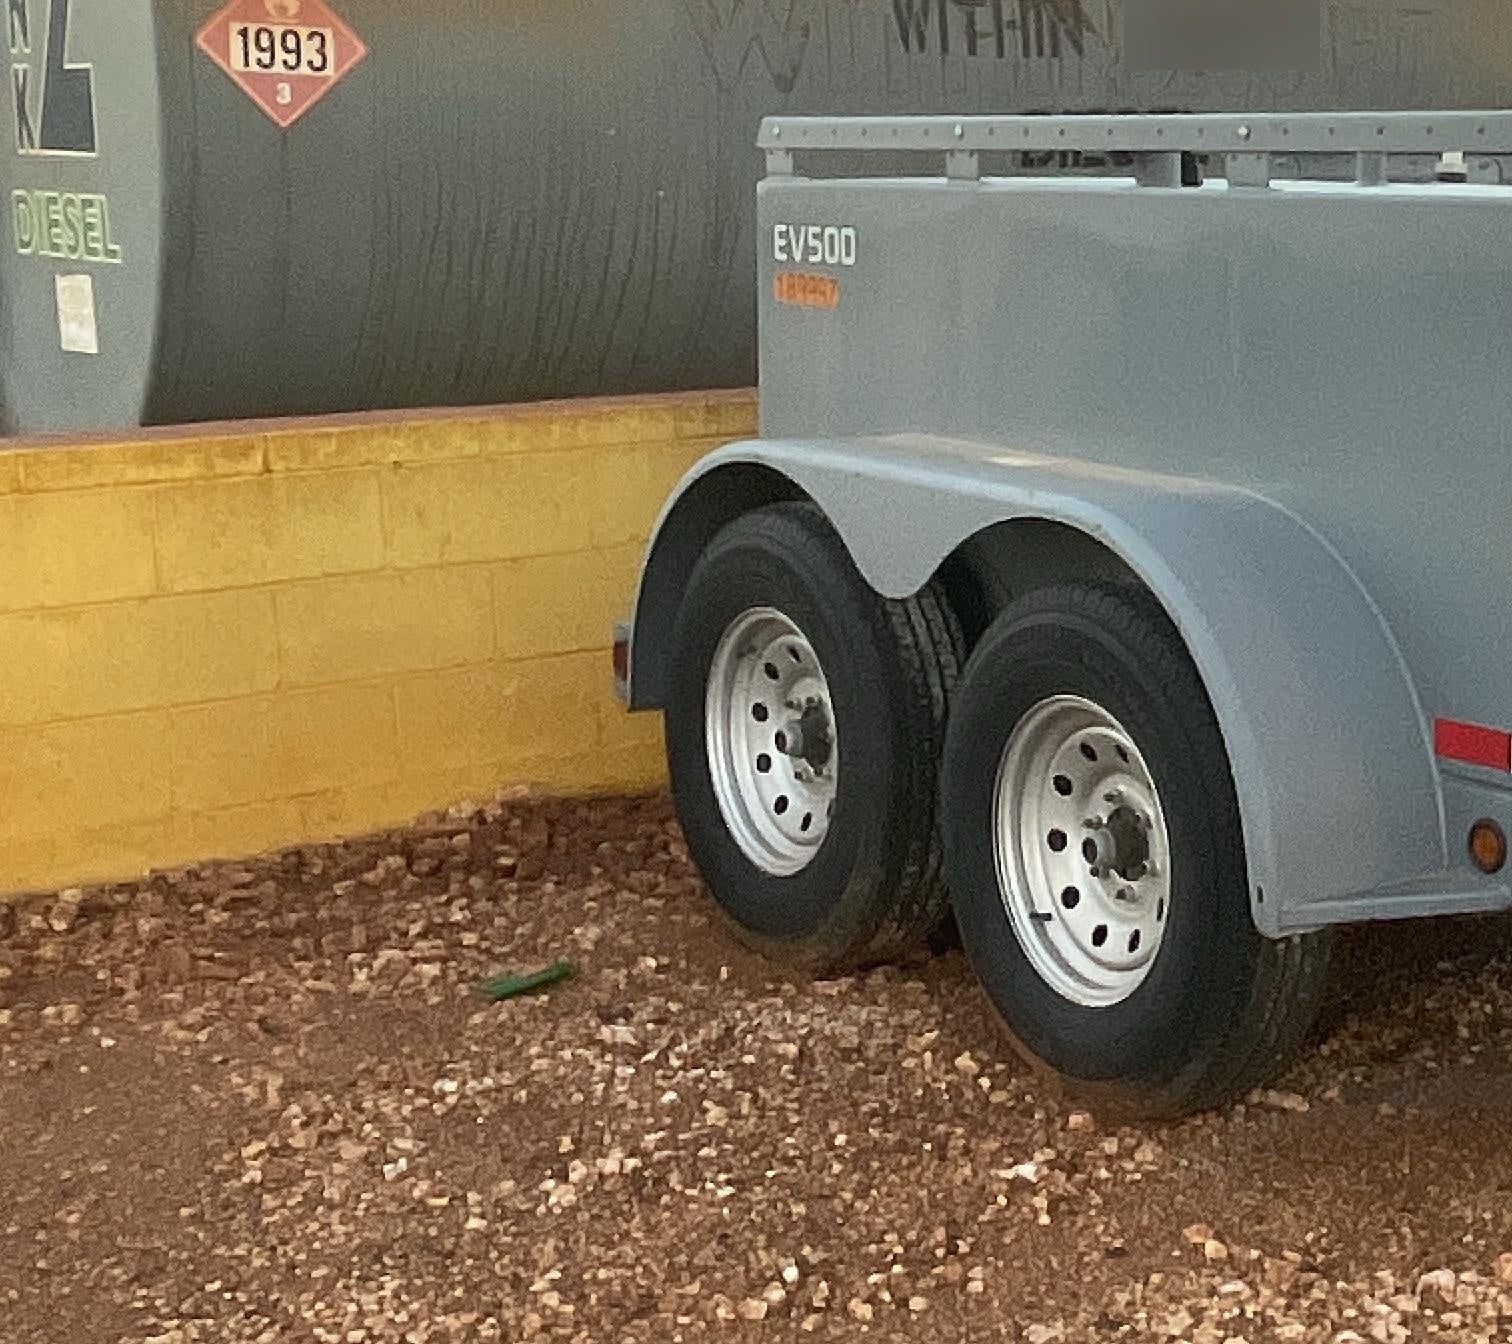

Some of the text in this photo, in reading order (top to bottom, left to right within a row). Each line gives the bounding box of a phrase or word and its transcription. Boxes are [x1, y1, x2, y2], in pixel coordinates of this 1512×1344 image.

[236, 26, 329, 73] 1993
[276, 81, 292, 105] 3
[11, 189, 122, 264] DIESEL
[773, 223, 857, 266] EV500
